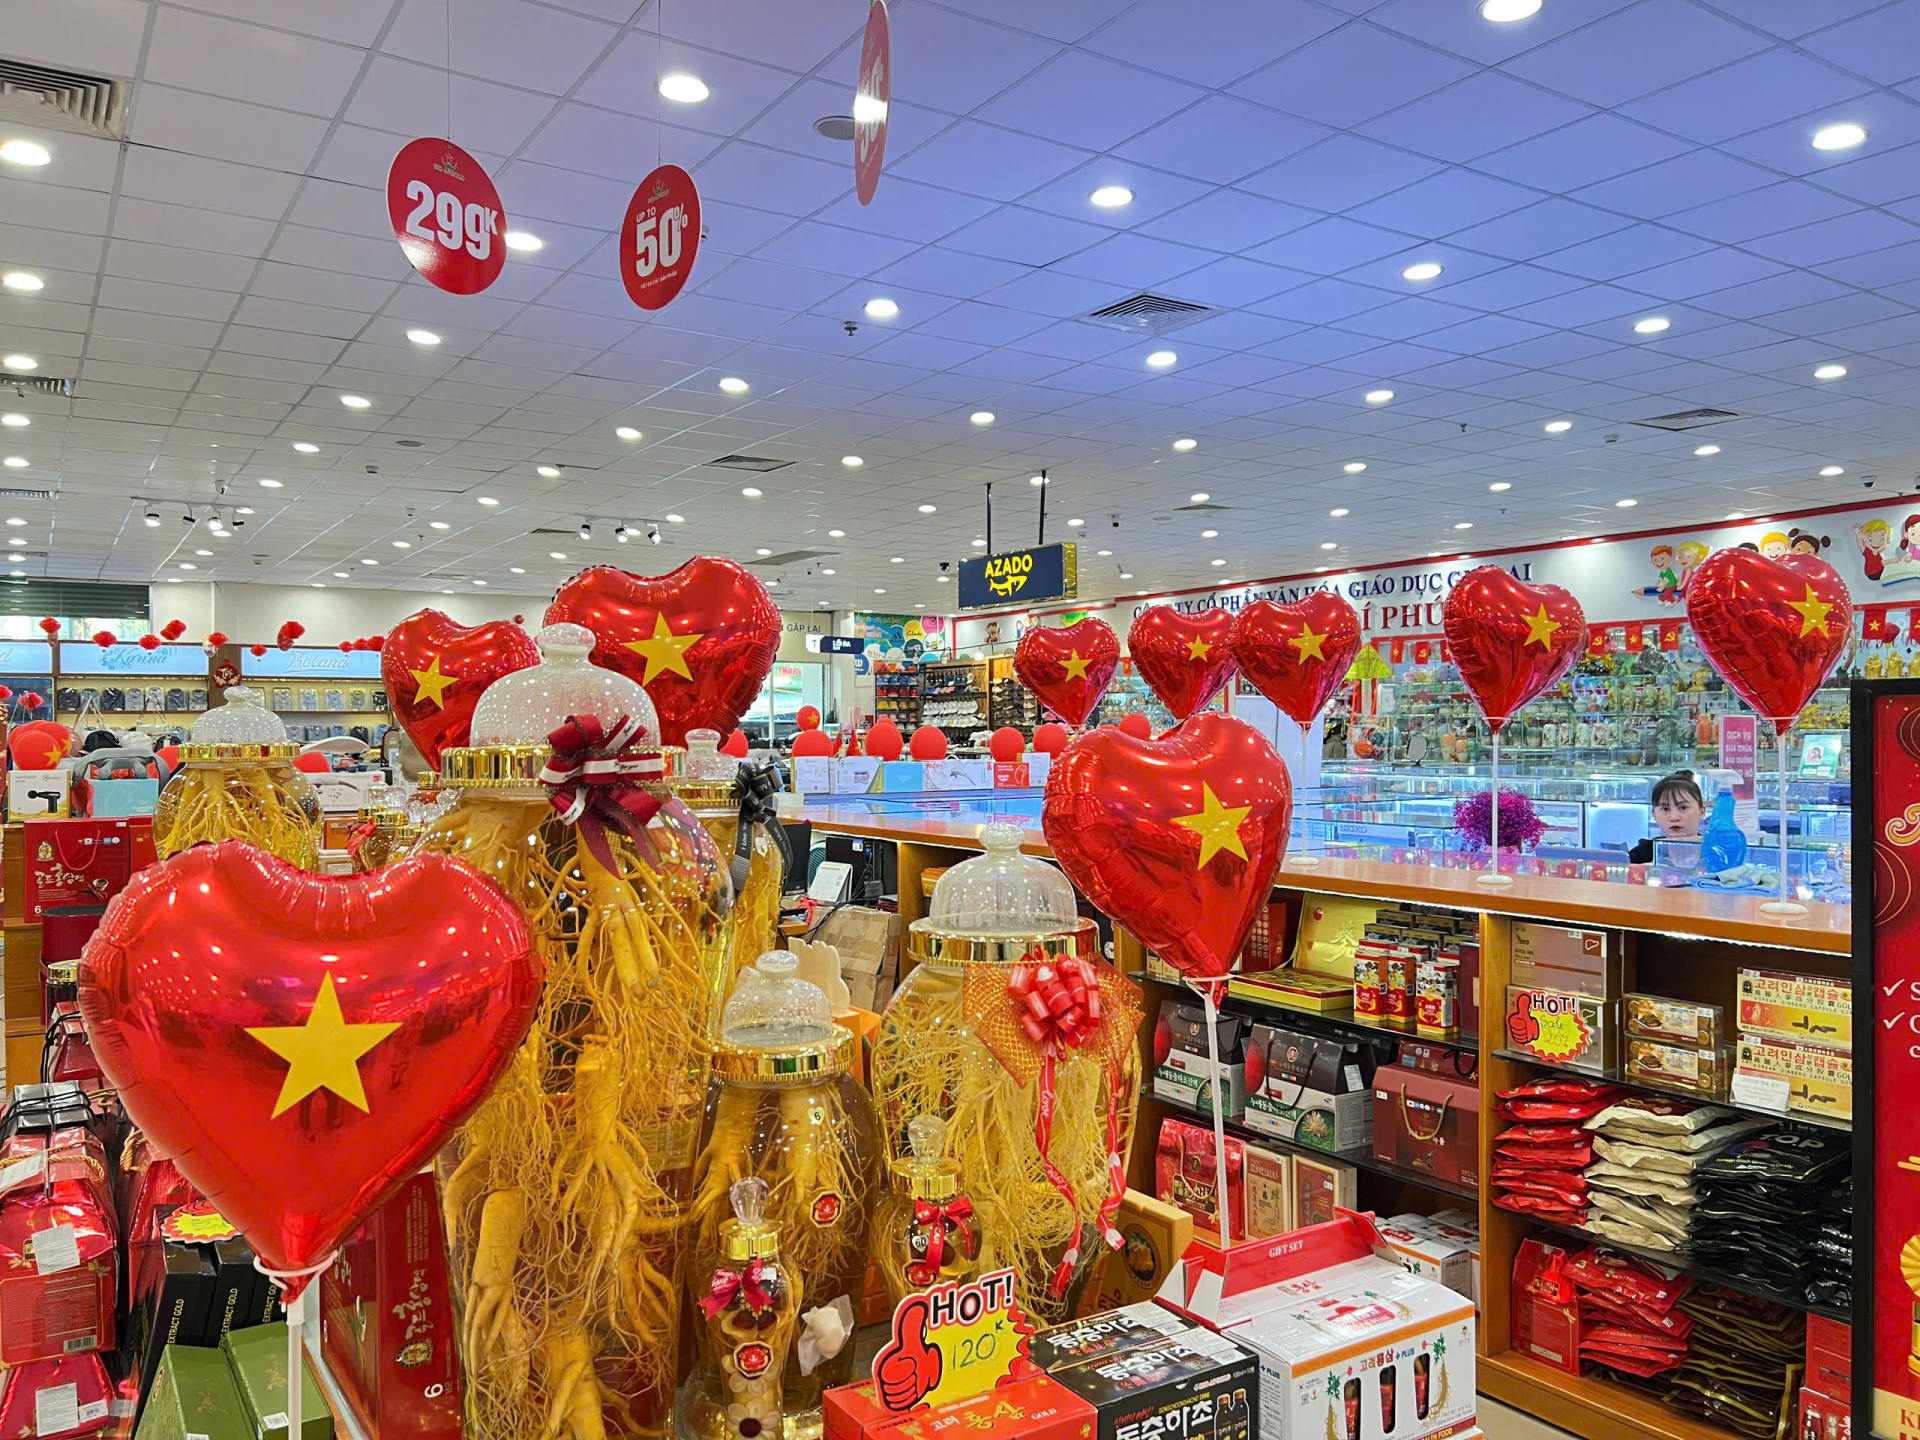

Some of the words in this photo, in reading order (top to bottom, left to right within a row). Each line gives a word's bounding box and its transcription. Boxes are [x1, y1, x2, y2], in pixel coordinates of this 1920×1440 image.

[636, 211, 646, 223] UP
[646, 206, 656, 218] TO
[636, 203, 688, 277] 50%
[985, 554, 1033, 578] AZADO
[1197, 592, 1217, 613] CỔ
[1266, 586, 1299, 604] VĂN
[1348, 574, 1395, 598] GIÁO
[1402, 573, 1442, 595] DỤC
[288, 651, 349, 669] Roland
[1726, 731, 1741, 740] DỊCH
[1743, 732, 1752, 740] VỤ
[34, 905, 41, 914] 6
[1532, 993, 1576, 1014] HOT!
[1810, 1004, 1837, 1013] CAPSULE
[1540, 1014, 1565, 1030] Sale
[1781, 1069, 1806, 1077] GINSENG
[1810, 1074, 1837, 1083] CAPSULE
[1269, 1243, 1289, 1258] GIFT
[1288, 1240, 1304, 1252] SET
[173, 1298, 184, 1317] GOLD
[932, 1275, 1012, 1326] HOT!
[221, 1305, 233, 1336] EXTRACT
[227, 1287, 237, 1306] GOLD
[262, 1298, 273, 1323] EXTRACT
[168, 1317, 180, 1344] EXTRACT
[929, 1415, 960, 1432] 고려
[963, 1400, 1027, 1430] 홍삼
[1031, 1408, 1057, 1421] GOLD
[1438, 1427, 1453, 1439] FOOD
